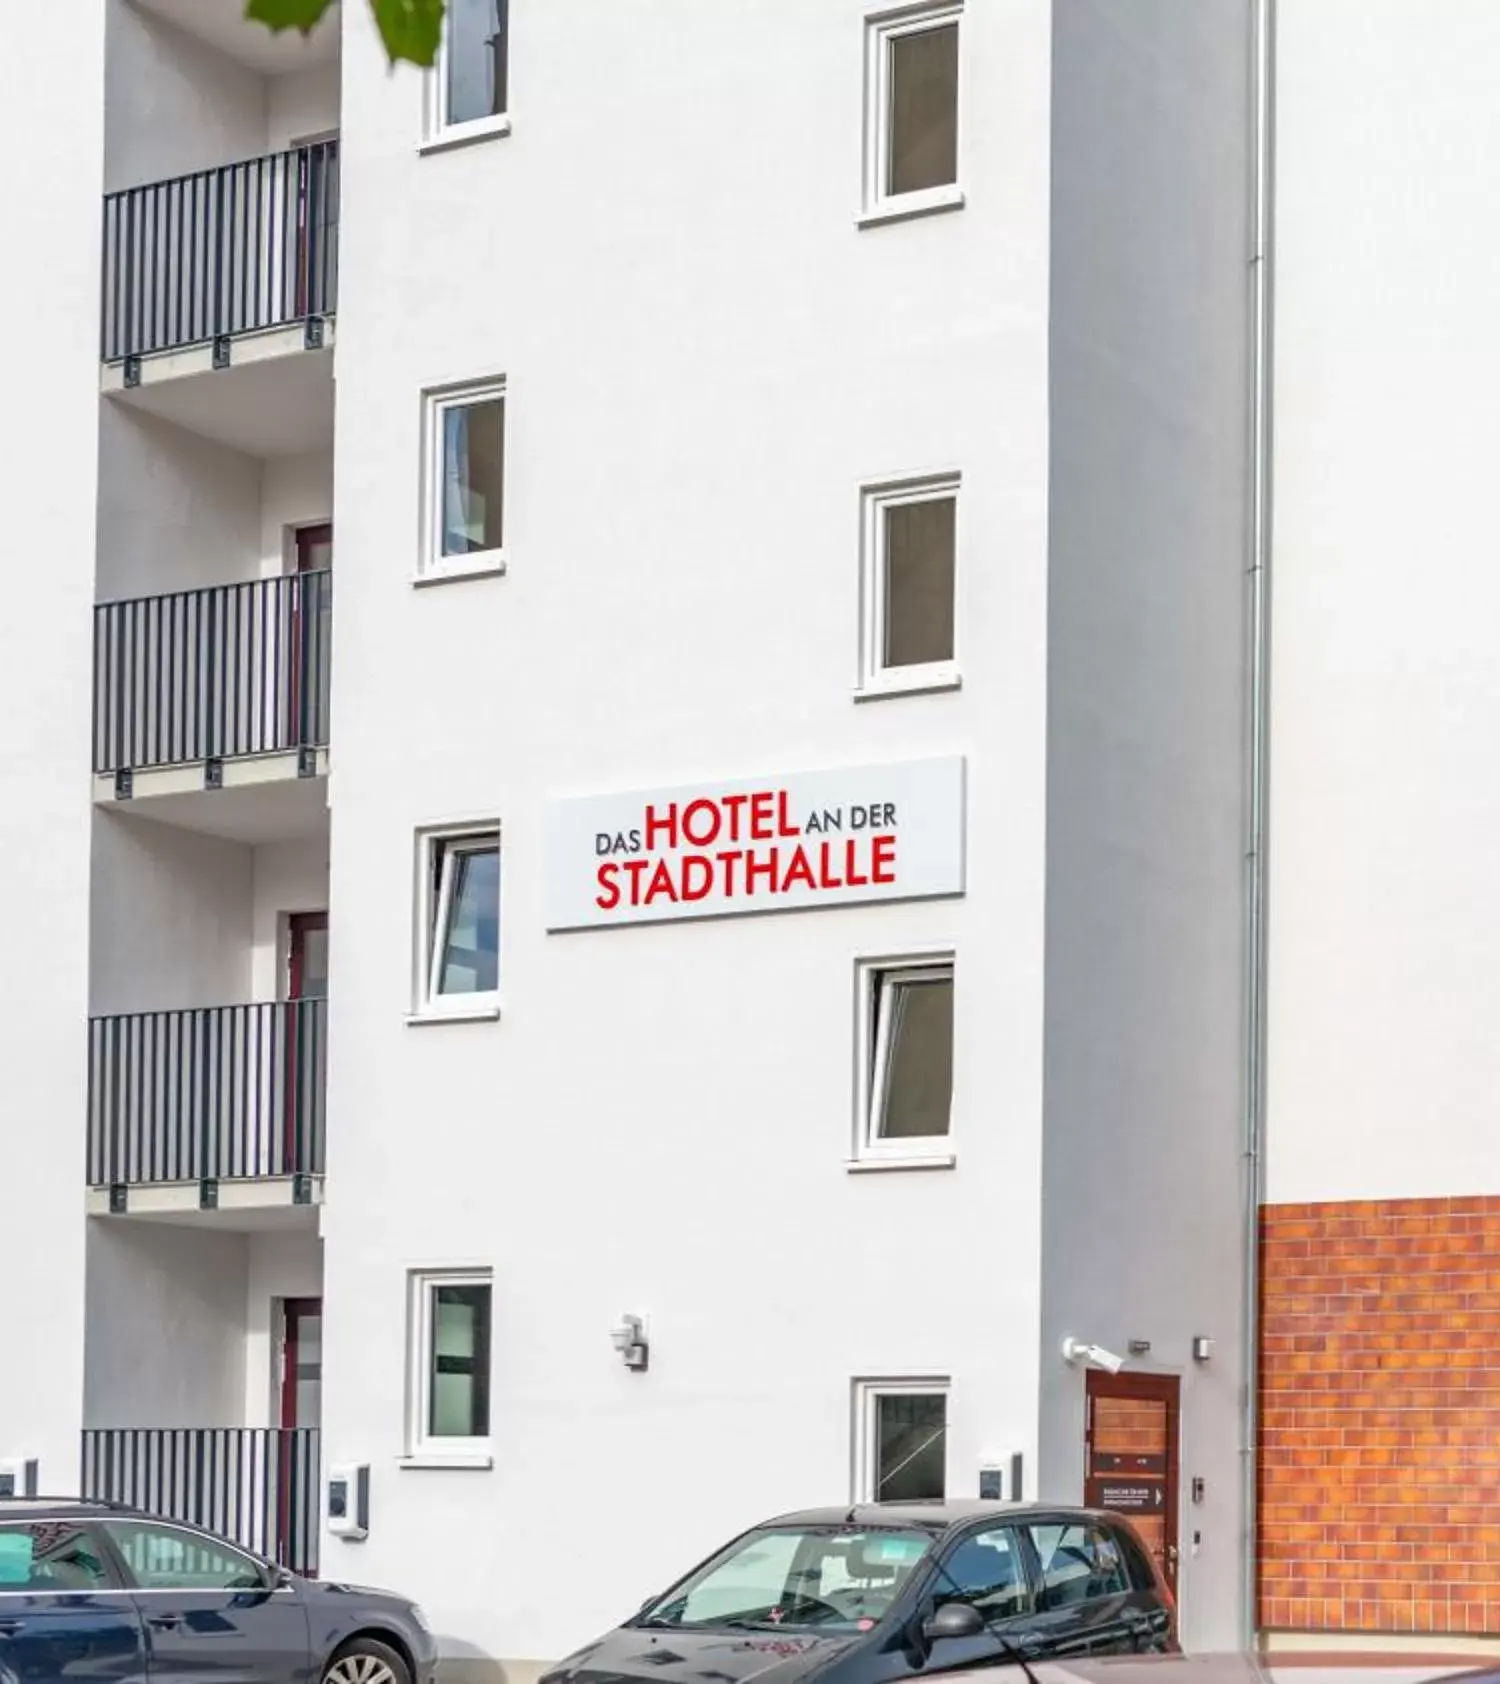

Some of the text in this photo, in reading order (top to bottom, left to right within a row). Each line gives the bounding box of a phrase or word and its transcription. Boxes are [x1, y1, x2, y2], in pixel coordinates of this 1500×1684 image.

[595, 788, 897, 856] DAS HOTEL AN DER
[595, 834, 898, 911] STADTHALLE
